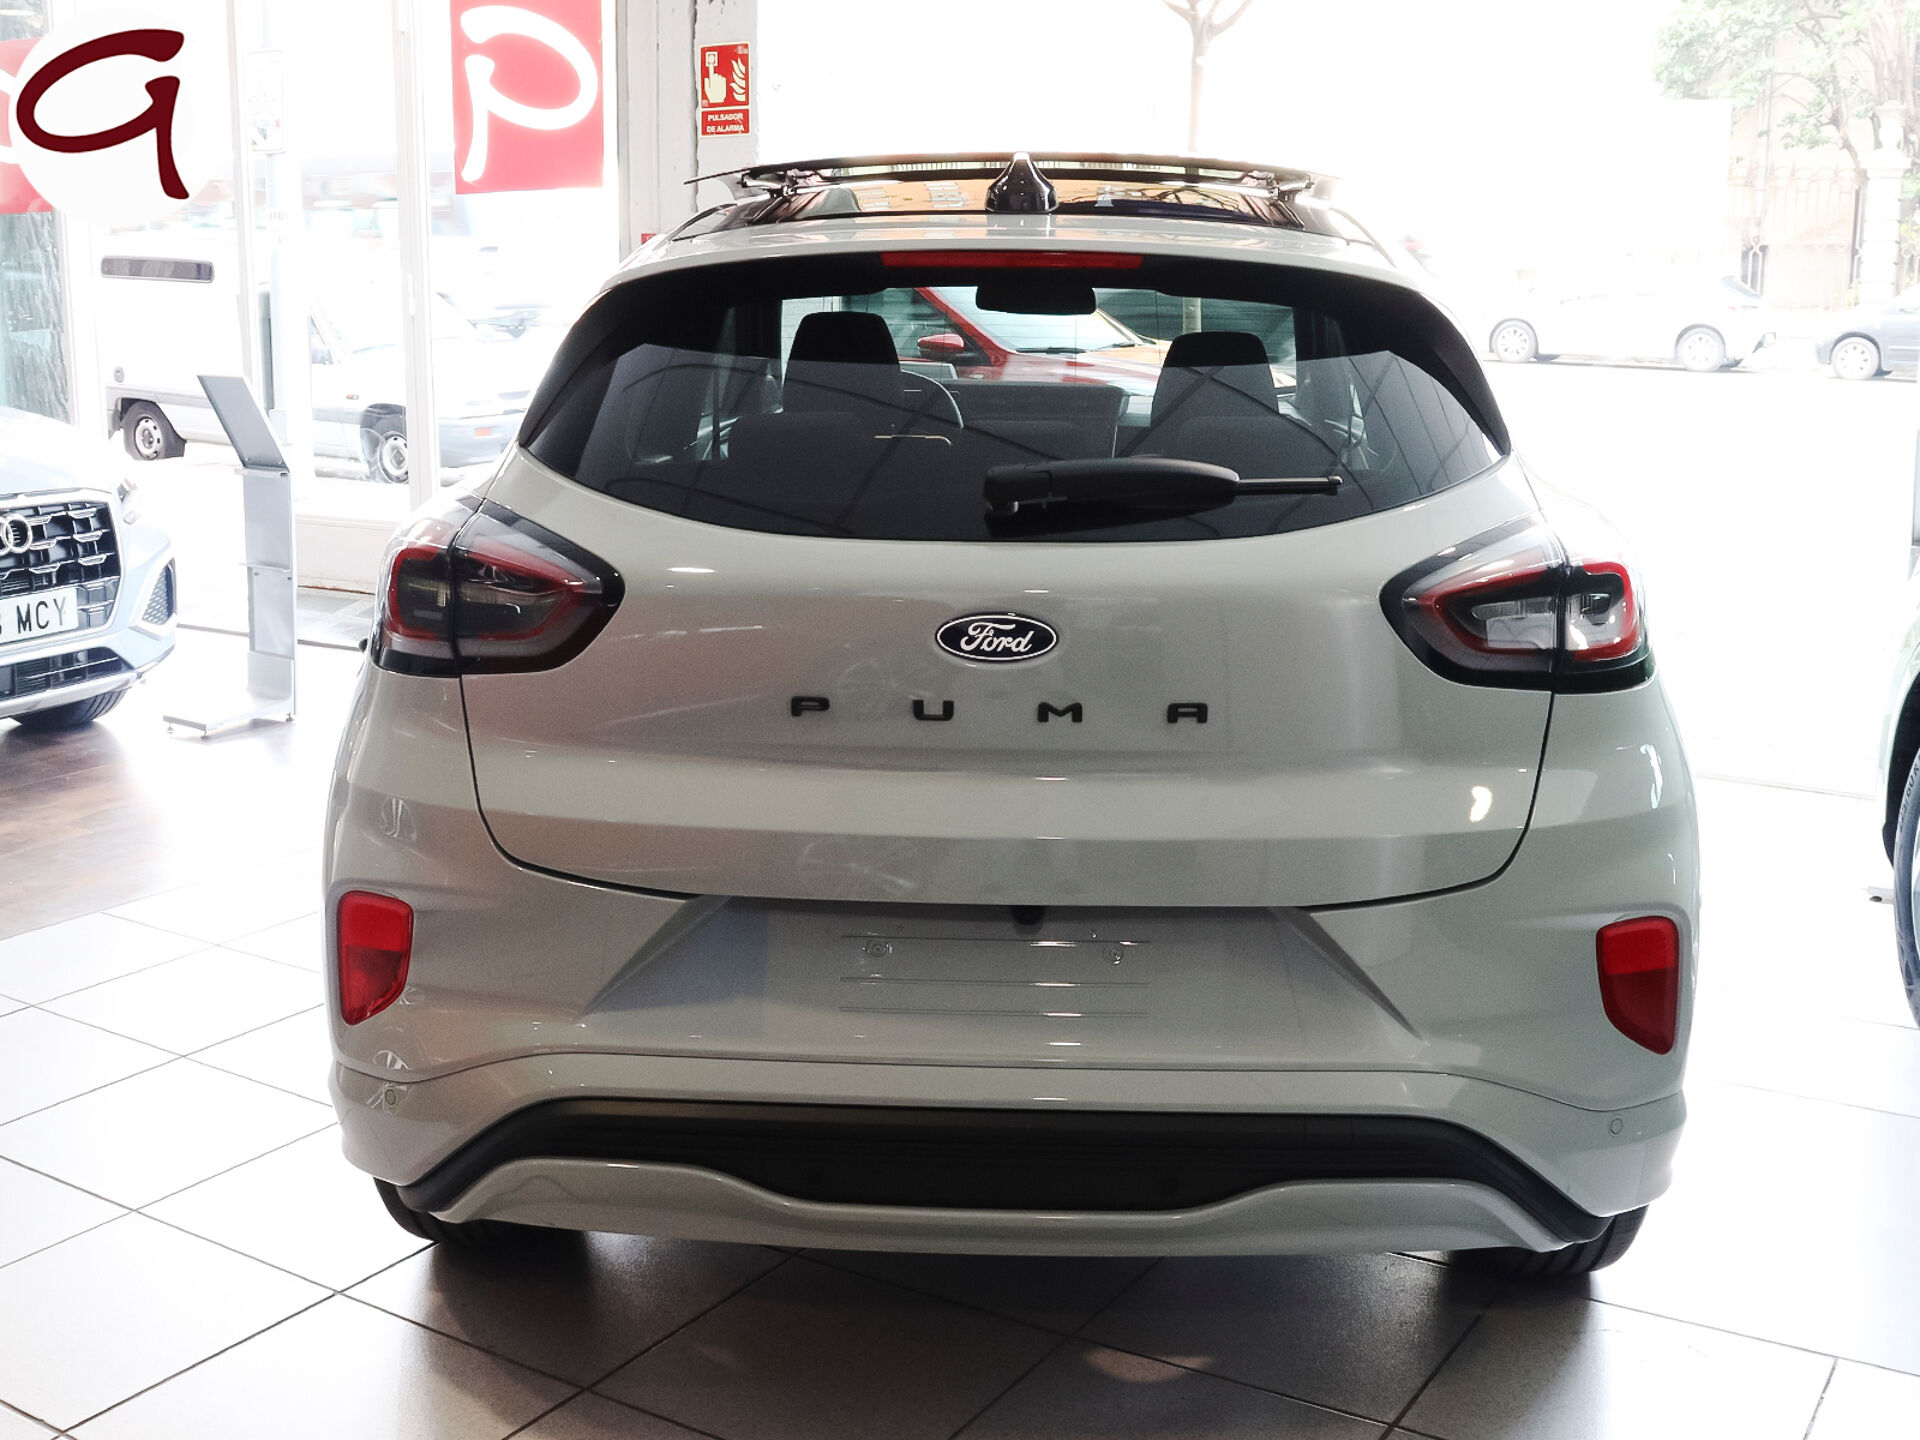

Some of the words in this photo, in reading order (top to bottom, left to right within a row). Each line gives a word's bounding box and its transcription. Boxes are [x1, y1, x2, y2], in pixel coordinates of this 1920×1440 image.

[706, 125, 716, 133] DE
[717, 124, 745, 132] ALARMA
[707, 113, 744, 121] PULSADOR
[16, 597, 67, 634] MCY
[960, 622, 1035, 652] Ford
[791, 696, 1208, 724] PUMA
